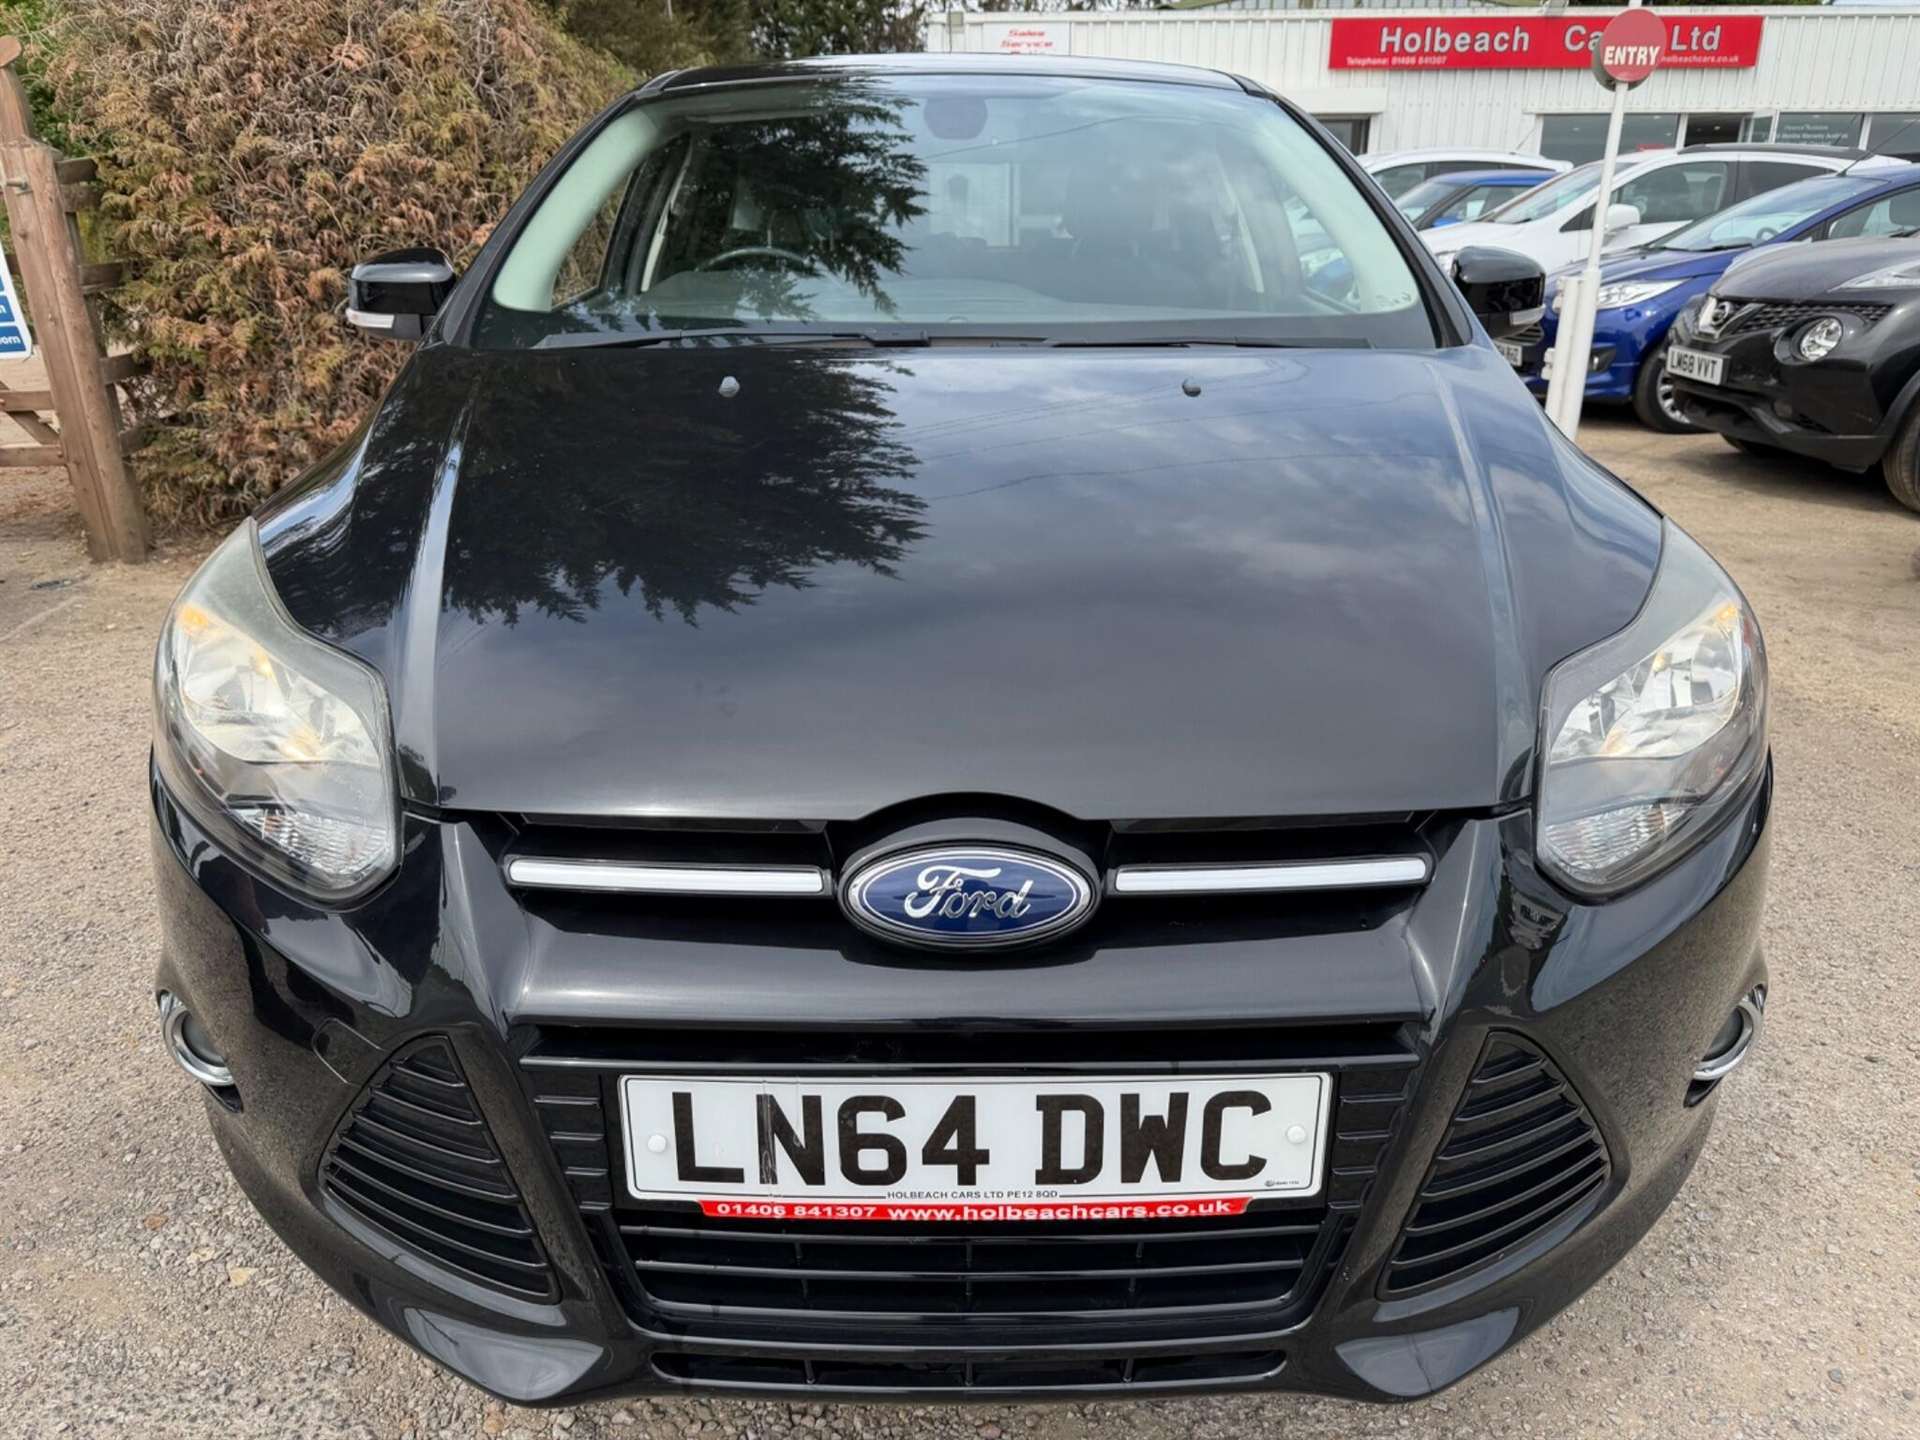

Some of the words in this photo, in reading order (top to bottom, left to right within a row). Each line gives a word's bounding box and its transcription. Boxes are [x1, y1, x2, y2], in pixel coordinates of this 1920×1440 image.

[1379, 26, 1530, 54] Holbeach
[1564, 25, 1604, 52] Ca
[1669, 25, 1722, 52] Ltd
[1603, 45, 1660, 66] ENTRY
[1670, 350, 1695, 373] LM68
[1697, 356, 1717, 379] VVT
[904, 865, 1034, 919] Ford
[671, 1090, 990, 1186] LN64
[1035, 1089, 1273, 1185] DWC
[887, 1190, 946, 1199] HOLBEACH
[951, 1190, 981, 1199] CARS
[983, 1190, 1004, 1199] LTD
[1007, 1189, 1033, 1199] PE12
[1036, 1189, 1058, 1199] 8QD
[717, 1203, 787, 1219] 01406
[793, 1204, 877, 1218] 841307
[888, 1199, 1231, 1221] www.holbeachcars.co.uk
